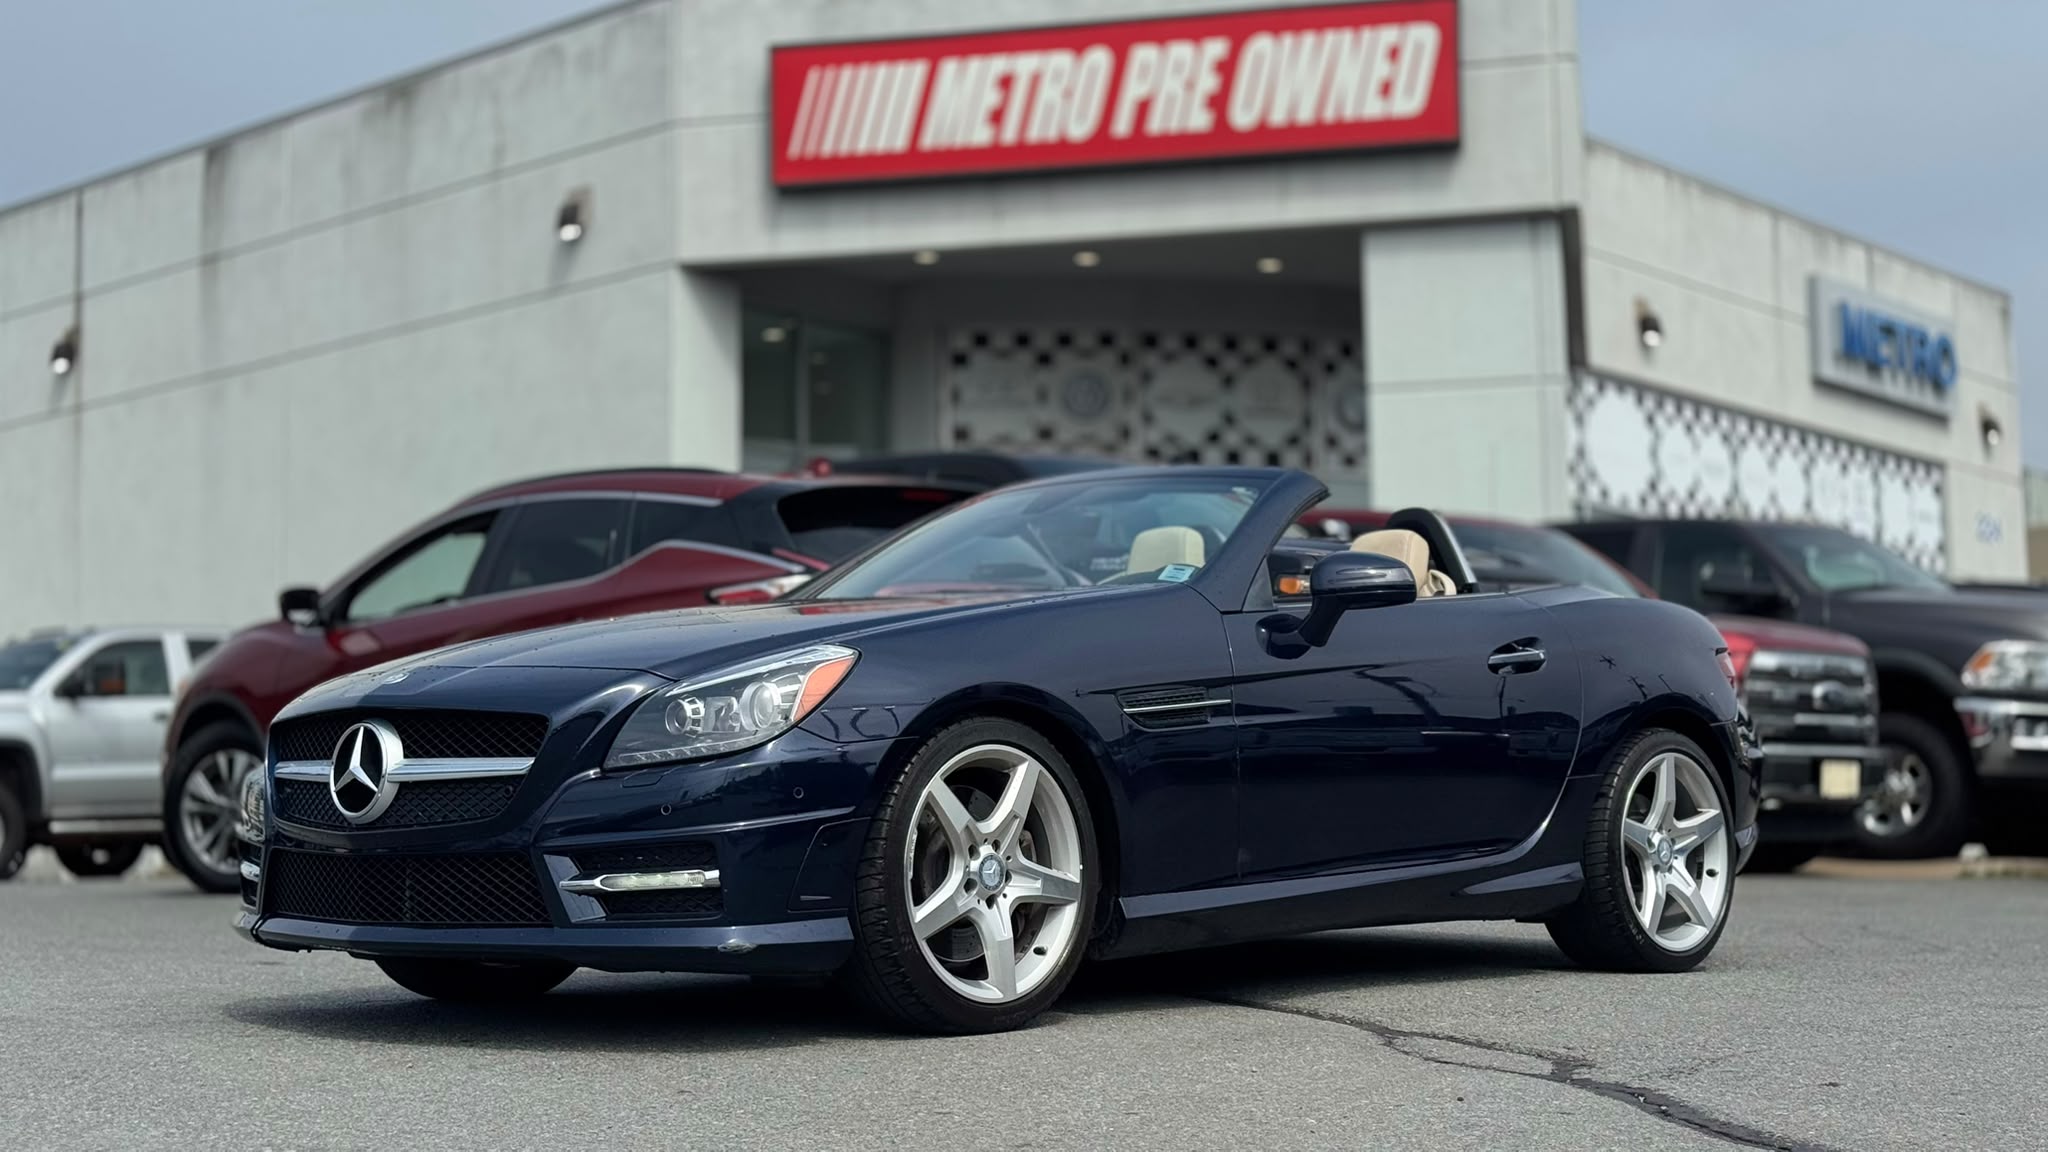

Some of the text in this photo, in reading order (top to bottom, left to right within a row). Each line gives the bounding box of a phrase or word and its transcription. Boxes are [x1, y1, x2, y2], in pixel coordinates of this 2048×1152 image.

[917, 22, 1441, 151] METRO PRE OWNED
[1841, 302, 1956, 389] METRO
